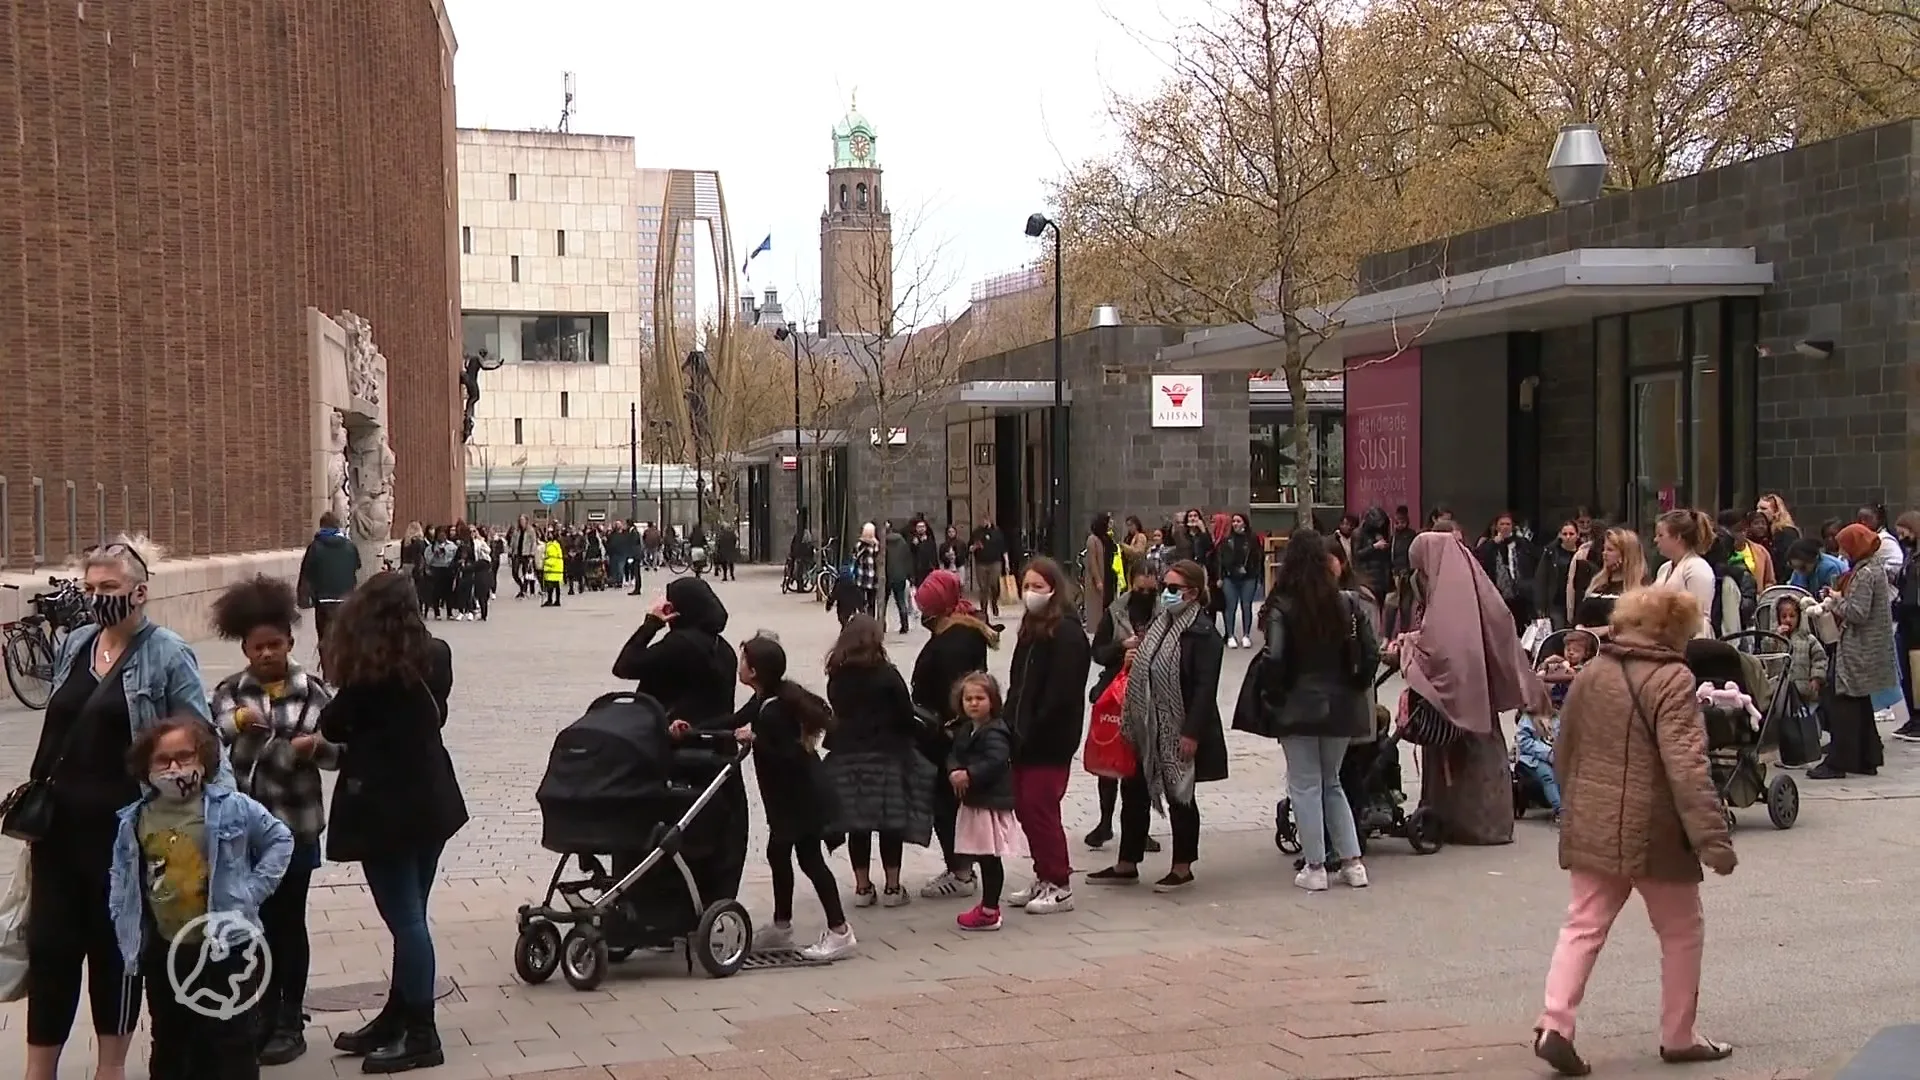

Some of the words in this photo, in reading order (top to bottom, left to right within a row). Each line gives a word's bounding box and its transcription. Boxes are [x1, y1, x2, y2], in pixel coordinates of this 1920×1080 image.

[1158, 411, 1198, 421] AJISAN
[1358, 411, 1407, 434] Handmade
[1359, 435, 1406, 470] SUSHI
[1359, 474, 1407, 496] throughout
